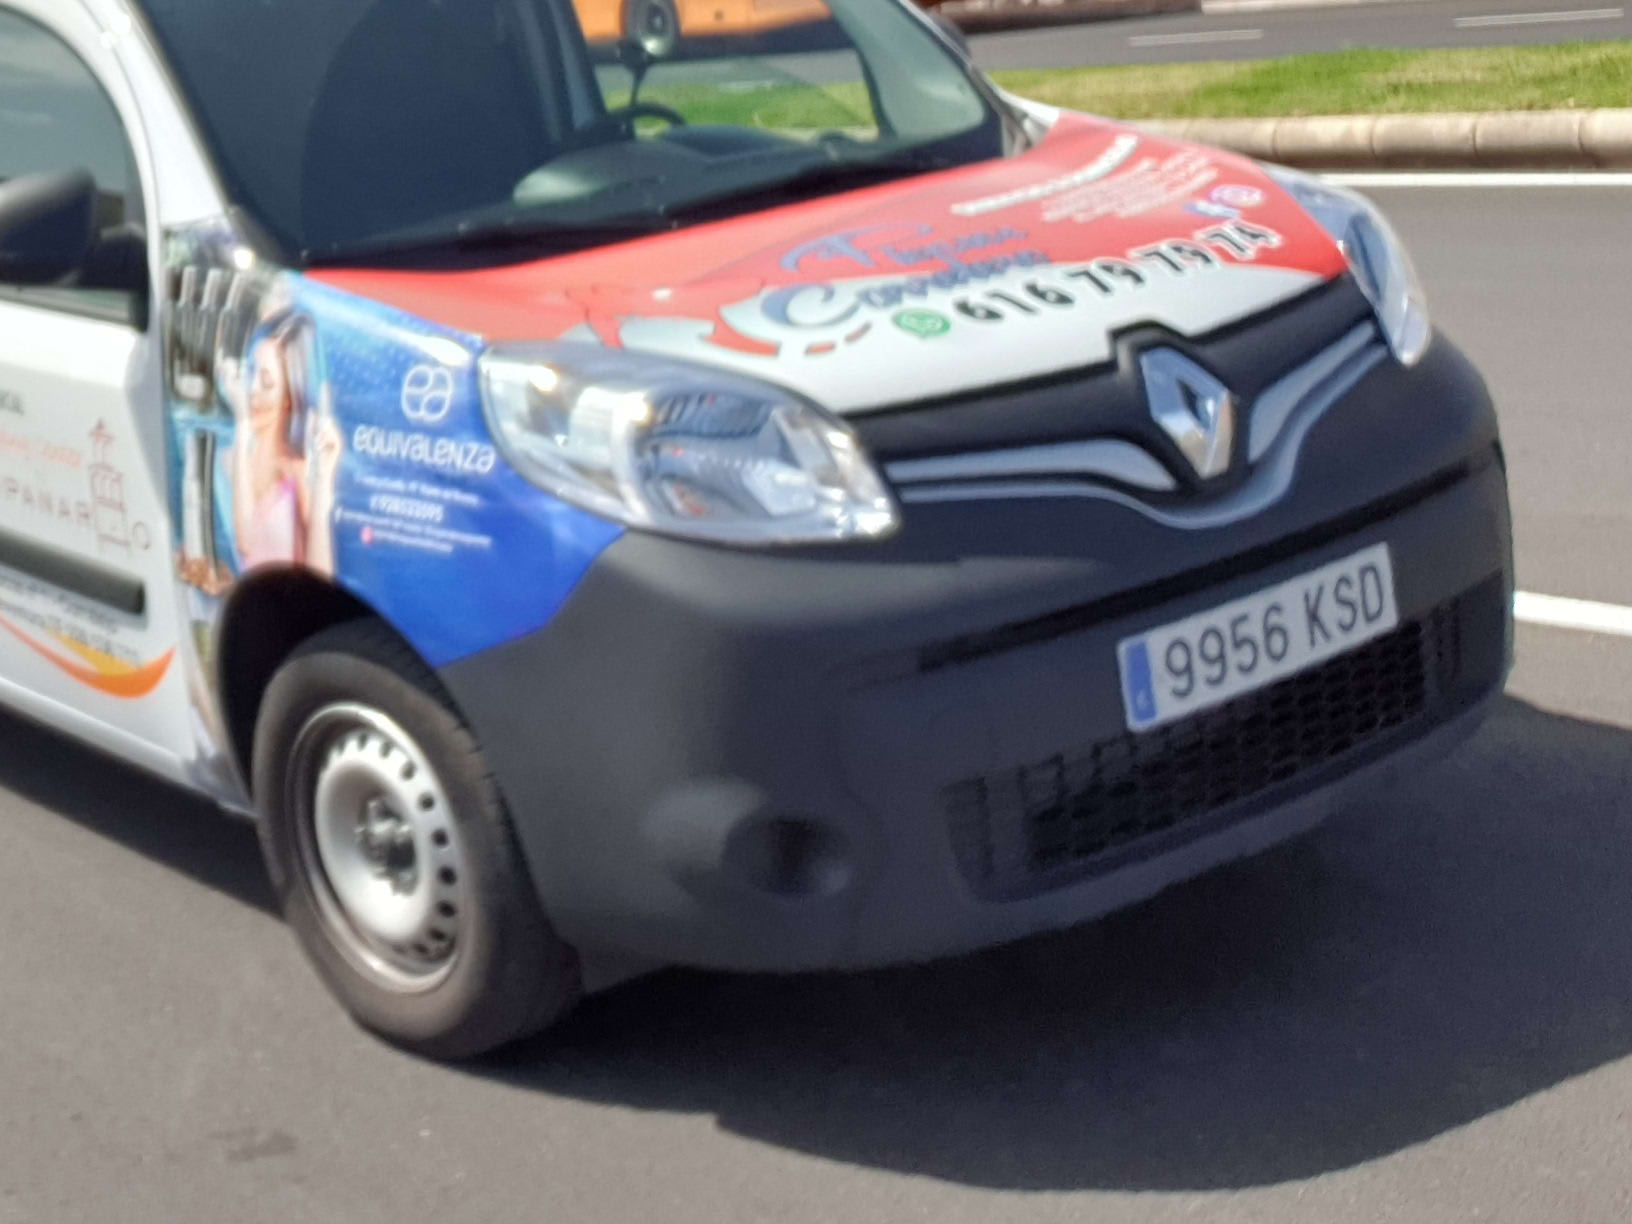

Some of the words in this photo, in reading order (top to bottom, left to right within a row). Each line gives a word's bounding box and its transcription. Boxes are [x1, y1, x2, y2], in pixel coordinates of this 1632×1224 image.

[953, 278, 1075, 323] 616
[1067, 261, 1146, 295] 79
[1142, 241, 1218, 275] 79
[1165, 602, 1290, 699] 9956
[1304, 564, 1384, 651] KSD
